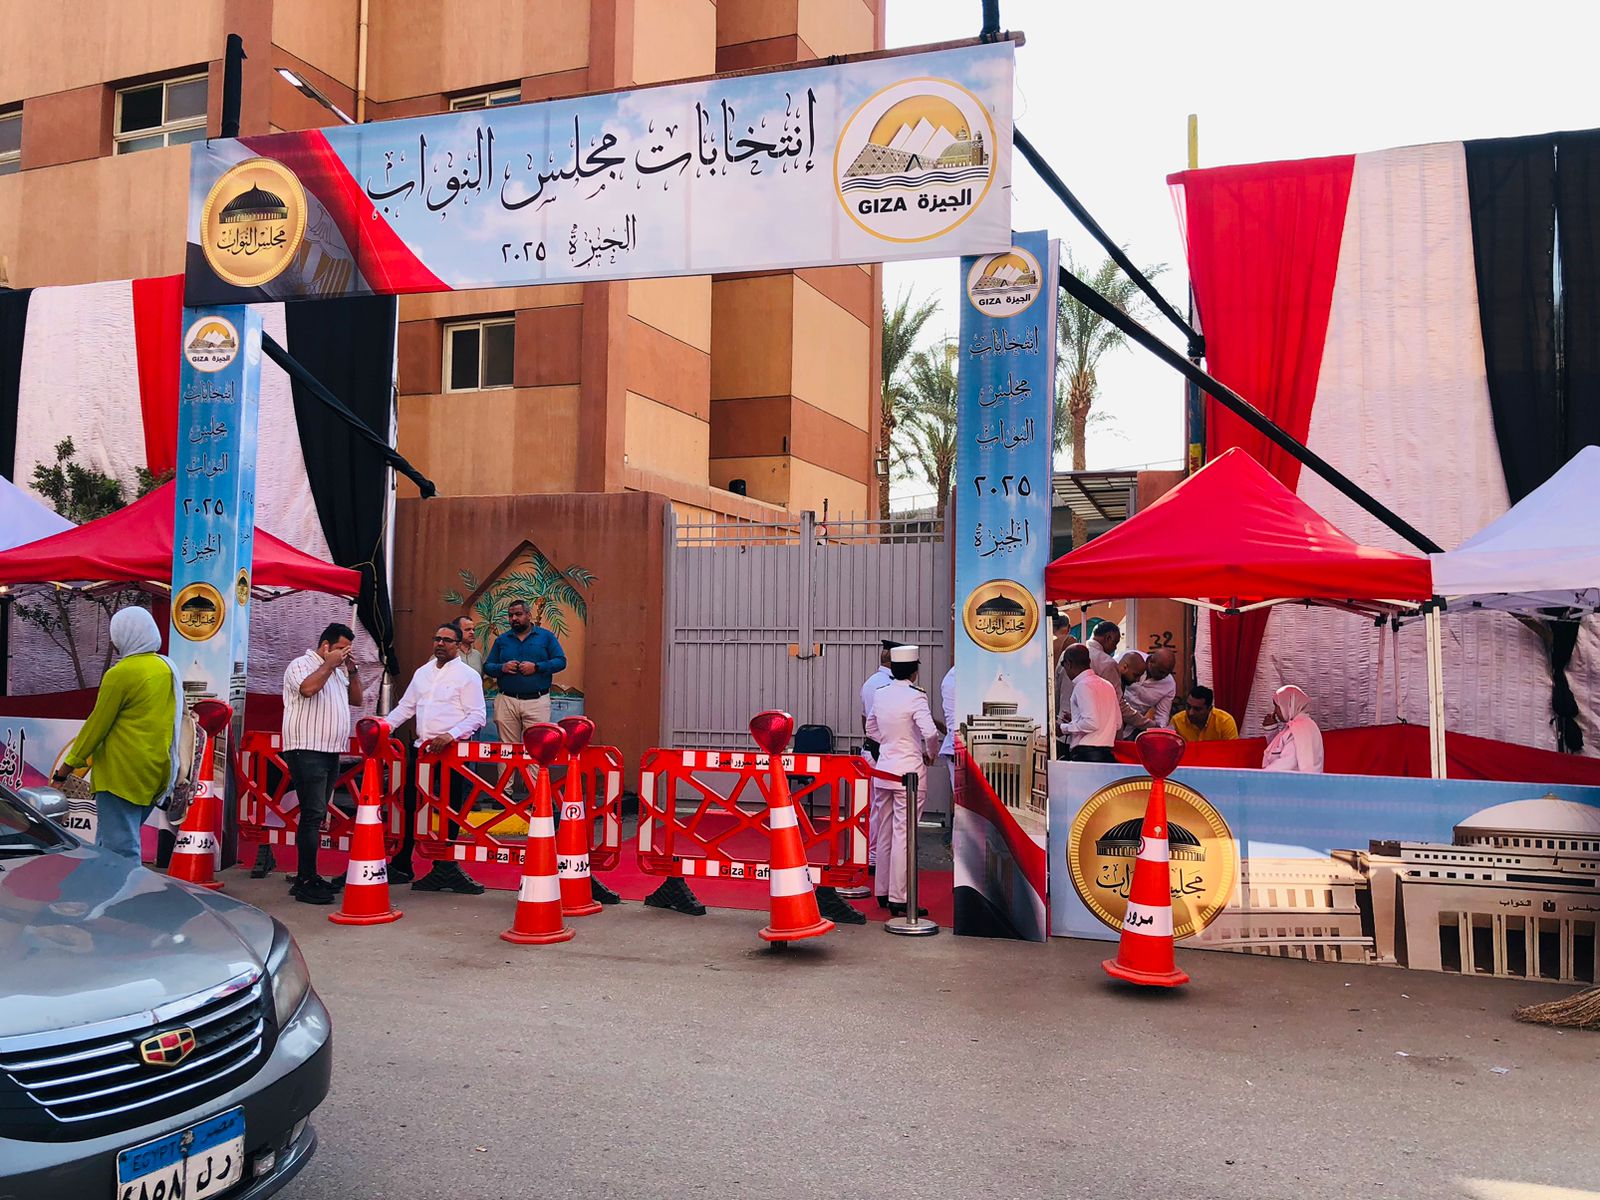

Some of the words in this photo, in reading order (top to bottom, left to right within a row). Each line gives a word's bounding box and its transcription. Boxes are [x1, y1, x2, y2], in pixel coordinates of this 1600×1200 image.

[366, 126, 495, 222] النواب
[500, 114, 626, 212] مجلس
[858, 196, 908, 215] GIZA
[917, 188, 972, 213] الجيزة
[216, 226, 258, 256] النواب
[245, 225, 287, 256] مجلس
[567, 214, 637, 268] الجيزة
[501, 241, 547, 264] ٢٠٢٥
[978, 297, 1002, 306] GIZA
[1005, 293, 1031, 305] الجيزة
[211, 354, 231, 363] الجيزة
[978, 372, 1031, 407] مجلس
[189, 416, 228, 443] مجلس
[975, 417, 1035, 450] النواب
[185, 453, 229, 477] النواب
[973, 475, 1031, 497] ٢٠٢٥
[183, 498, 224, 516] ٢٠٢٥
[180, 533, 222, 564] الجيزة
[973, 518, 1030, 557] الجيزة
[975, 618, 1005, 635] النواب
[995, 618, 1026, 635] مجلس
[1149, 631, 1176, 648] 32
[176, 835, 196, 848] الجي
[487, 849, 509, 861] Giza
[363, 865, 386, 881] جيزة
[720, 864, 744, 877] Giza
[747, 866, 770, 879] Traff
[1125, 911, 1154, 927] مرور
[132, 1141, 177, 1172] EGYPT
